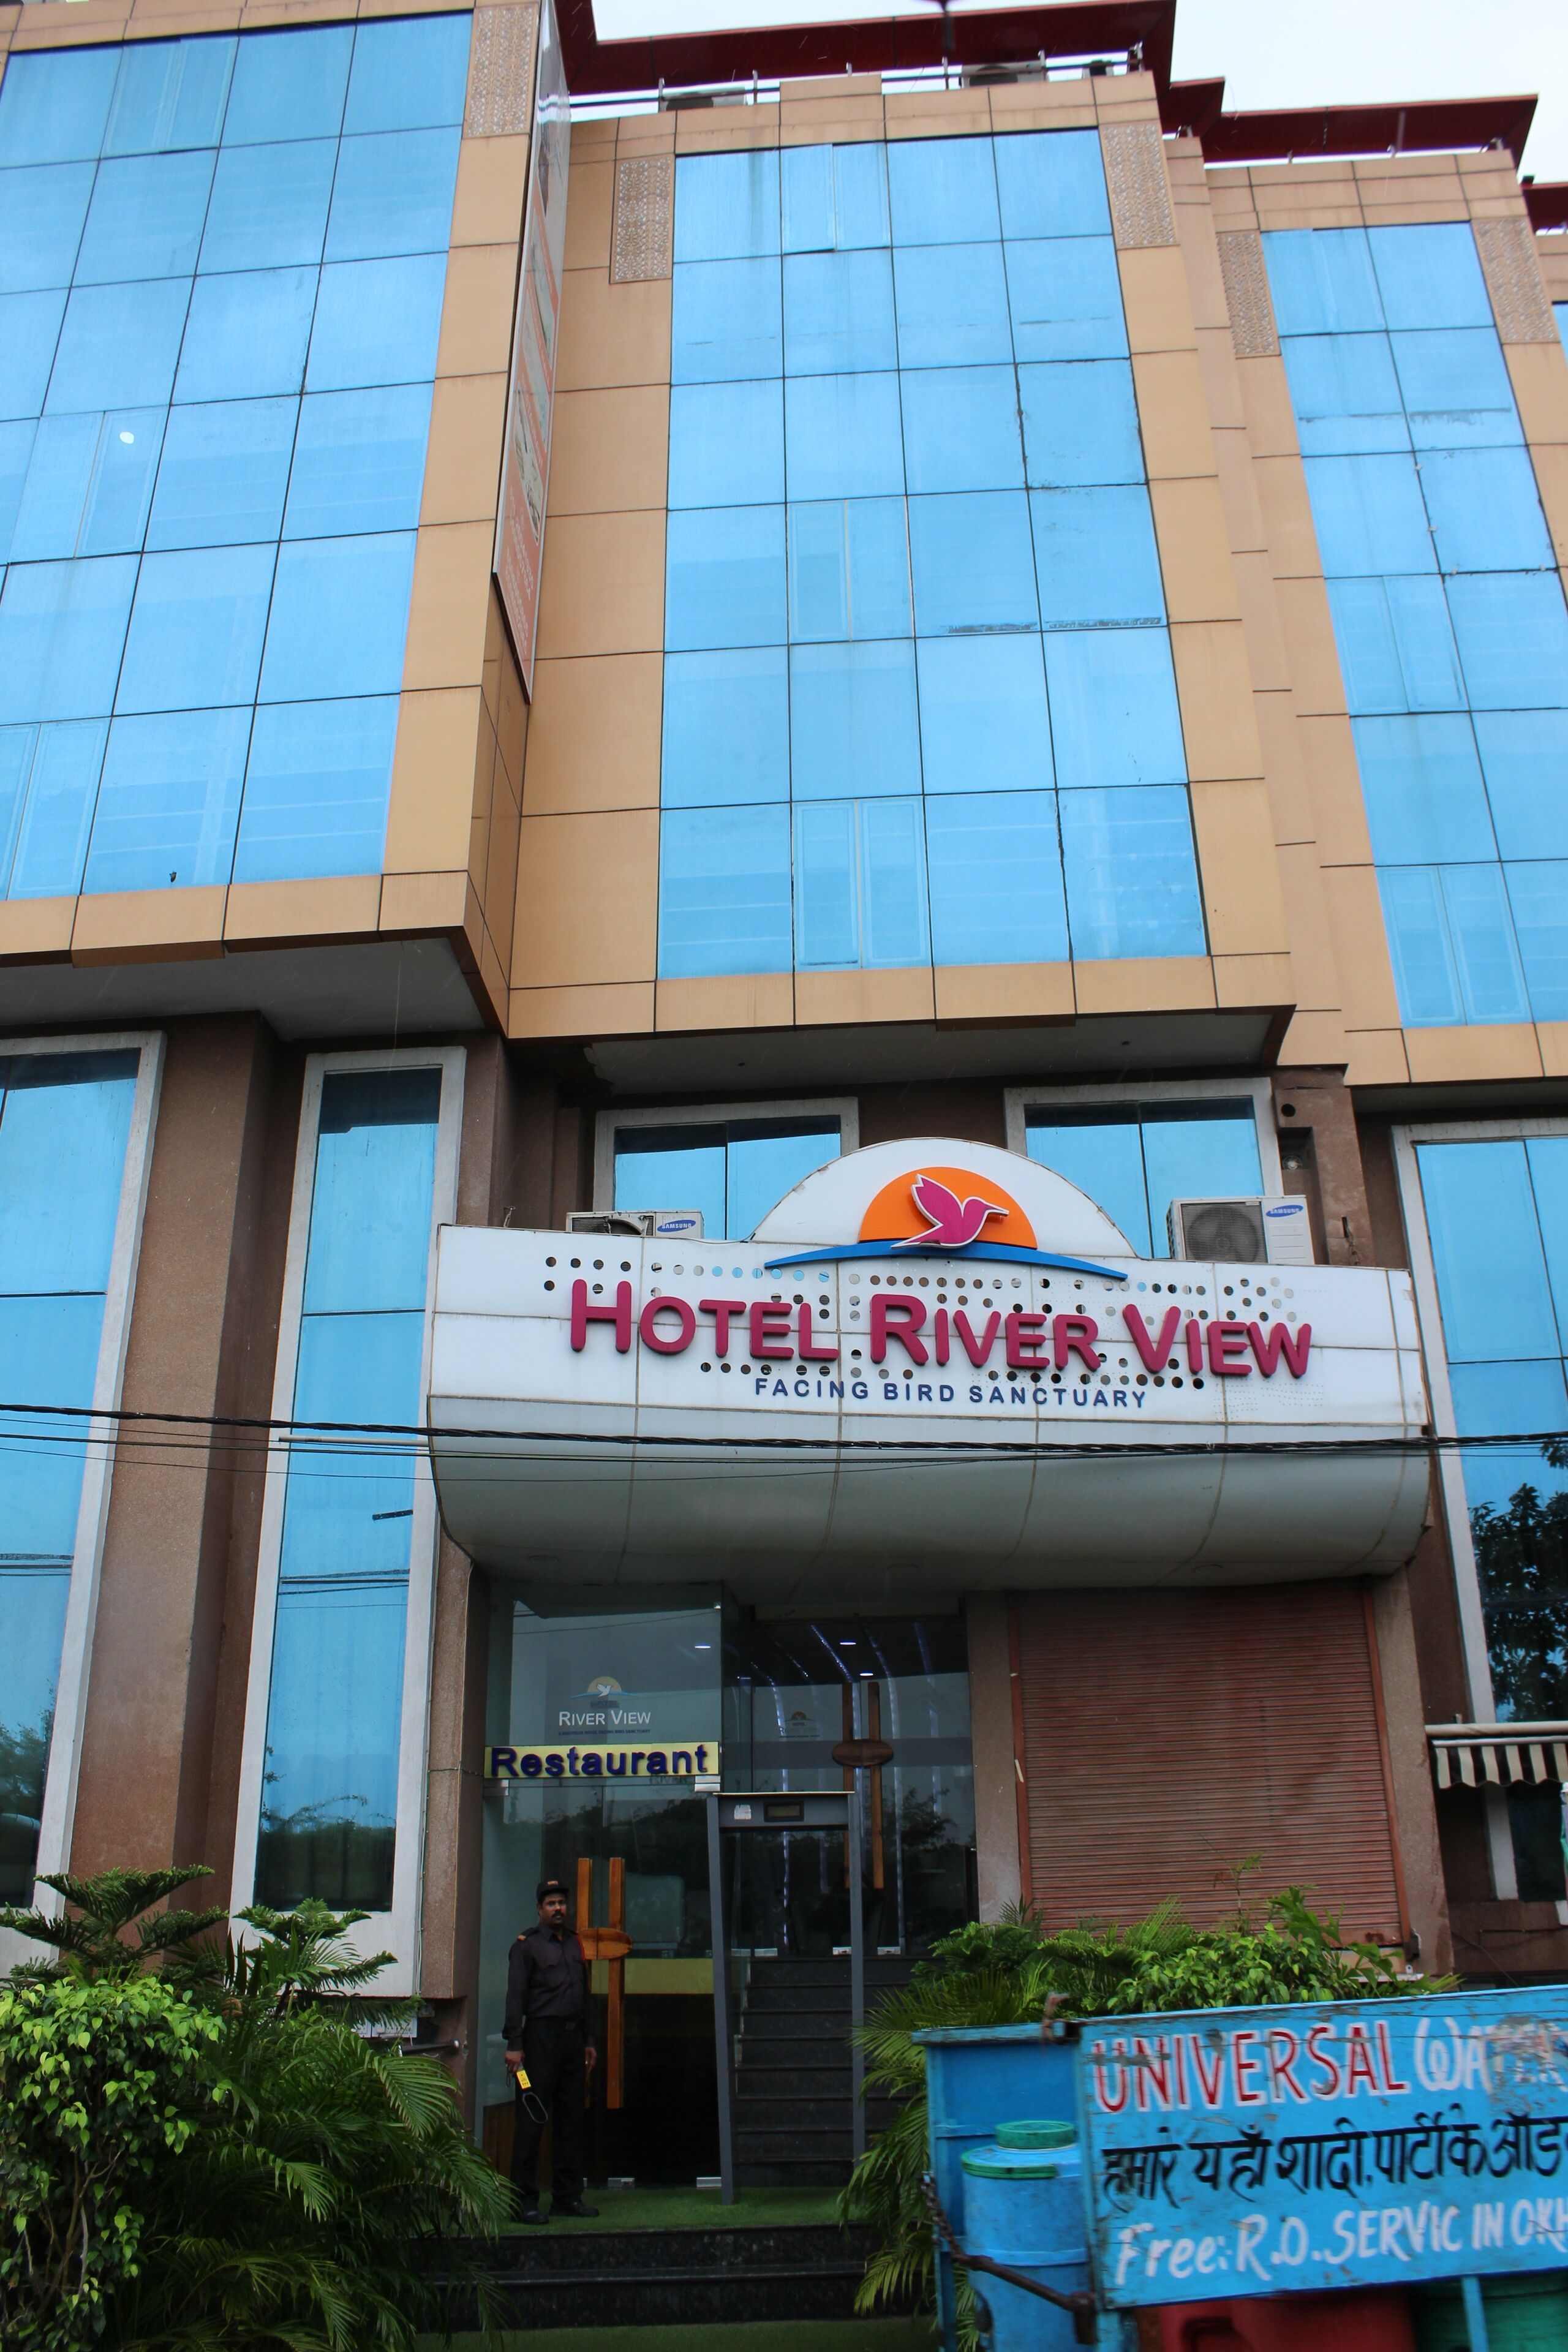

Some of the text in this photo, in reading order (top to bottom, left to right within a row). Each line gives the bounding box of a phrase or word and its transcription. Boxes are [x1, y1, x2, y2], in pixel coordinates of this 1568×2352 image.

[570, 1279, 1312, 1379] HOTEL RIVER VIEW
[755, 1378, 1145, 1408] FACING BIRD SANCTUARY
[559, 1709, 651, 1726] RIVER VIEW
[491, 1744, 708, 1777] Restaurant
[1093, 2020, 1411, 2113] UNIVERSAL
[1485, 2111, 1568, 2178] ऑड
[1472, 2201, 1506, 2250] IN
